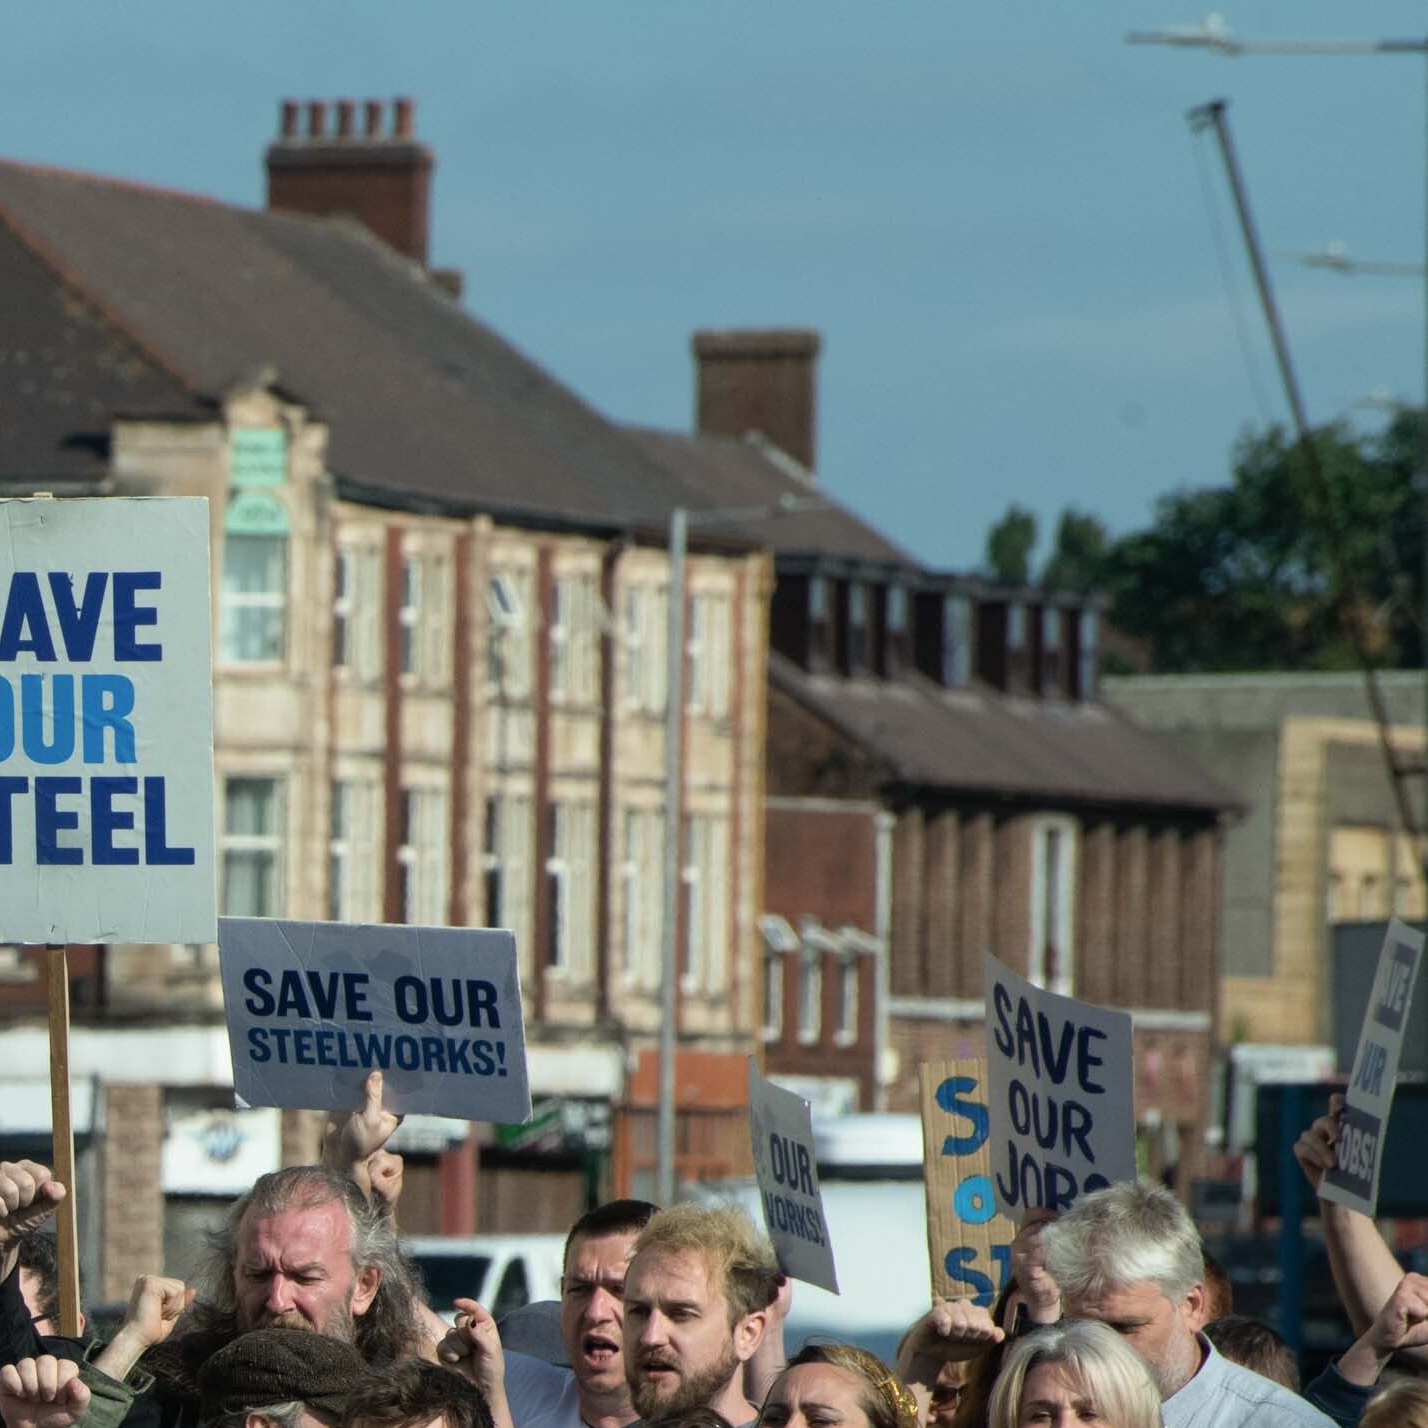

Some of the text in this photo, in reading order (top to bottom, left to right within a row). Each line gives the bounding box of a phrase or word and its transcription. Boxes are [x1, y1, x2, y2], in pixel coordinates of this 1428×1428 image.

[243, 968, 501, 1029] SAVE OUR
[247, 1027, 507, 1077] STEELWORKS!
[993, 981, 1107, 1094] SAVE
[1009, 1079, 1096, 1165] OUR
[770, 1133, 814, 1197] OUR
